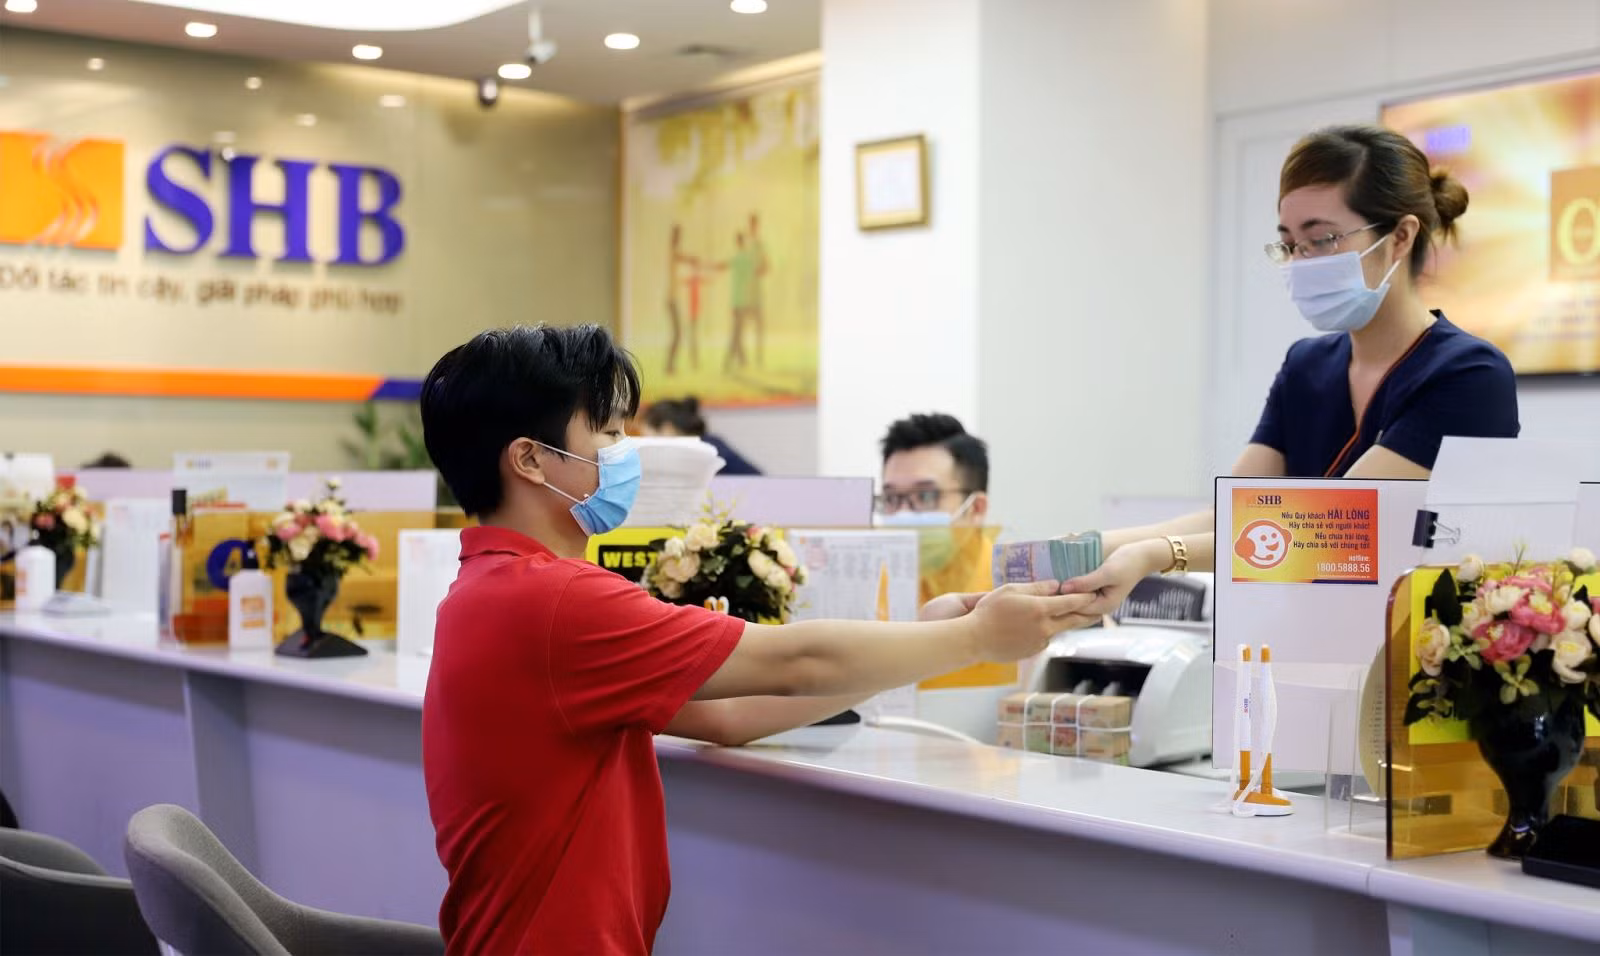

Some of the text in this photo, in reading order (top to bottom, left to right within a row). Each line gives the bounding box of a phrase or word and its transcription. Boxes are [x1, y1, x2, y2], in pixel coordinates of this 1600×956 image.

[144, 144, 406, 267] SHB
[1257, 495, 1282, 505] SHB
[1307, 511, 1326, 520] khách
[1327, 508, 1343, 520] HÀI
[1346, 508, 1370, 520] LÒNG
[1302, 521, 1315, 529] chia
[1306, 541, 1319, 549] chia
[1317, 561, 1371, 573] 1800.5888.56
